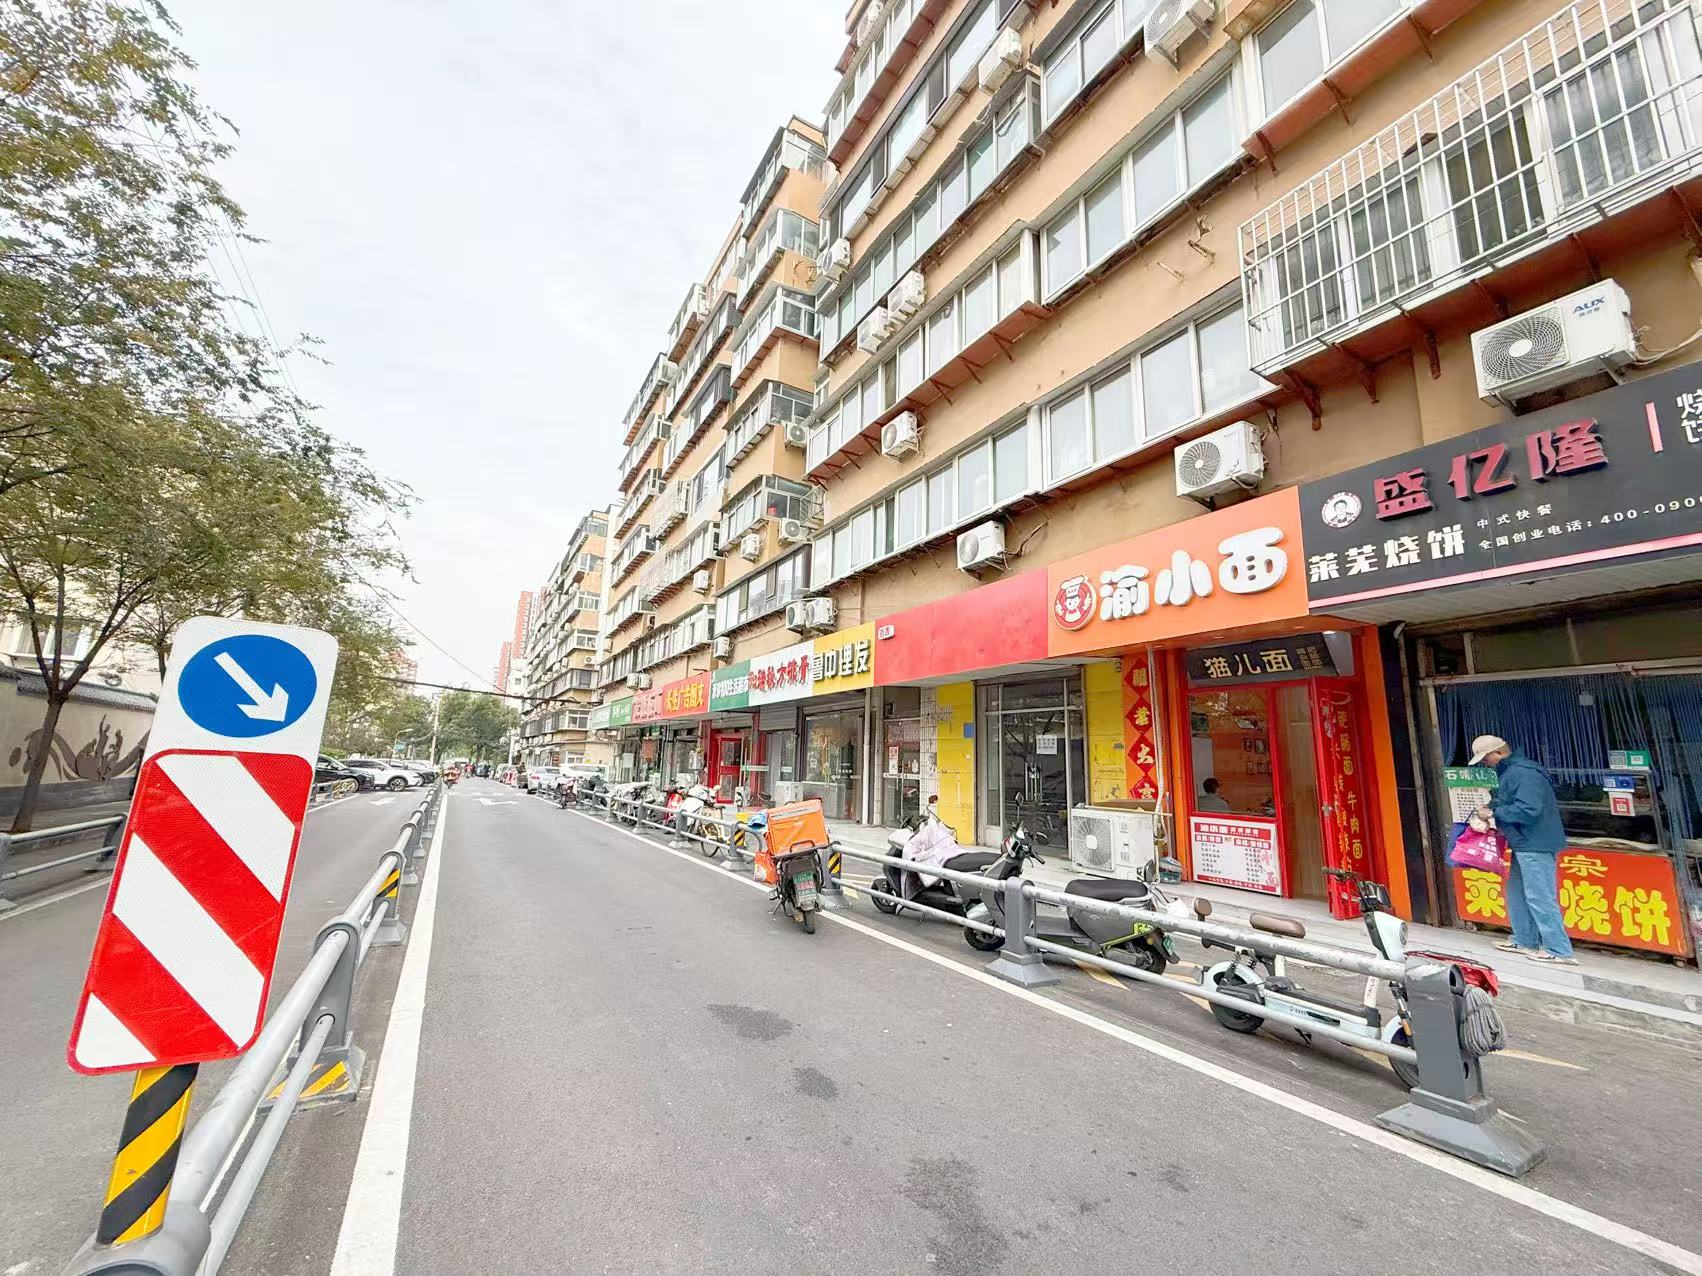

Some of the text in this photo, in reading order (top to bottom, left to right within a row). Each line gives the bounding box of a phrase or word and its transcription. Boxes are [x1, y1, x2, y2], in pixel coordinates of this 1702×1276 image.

[1573, 296, 1605, 314] AUX
[1373, 417, 1609, 520] 盛亿隆
[1477, 503, 1552, 529] 中式快餐
[1479, 496, 1702, 550] 全国创业电话：400-090
[1099, 527, 1288, 621] 渝小面
[1308, 524, 1465, 583] 莱芜烧饼
[1203, 649, 1293, 678] 猫儿面
